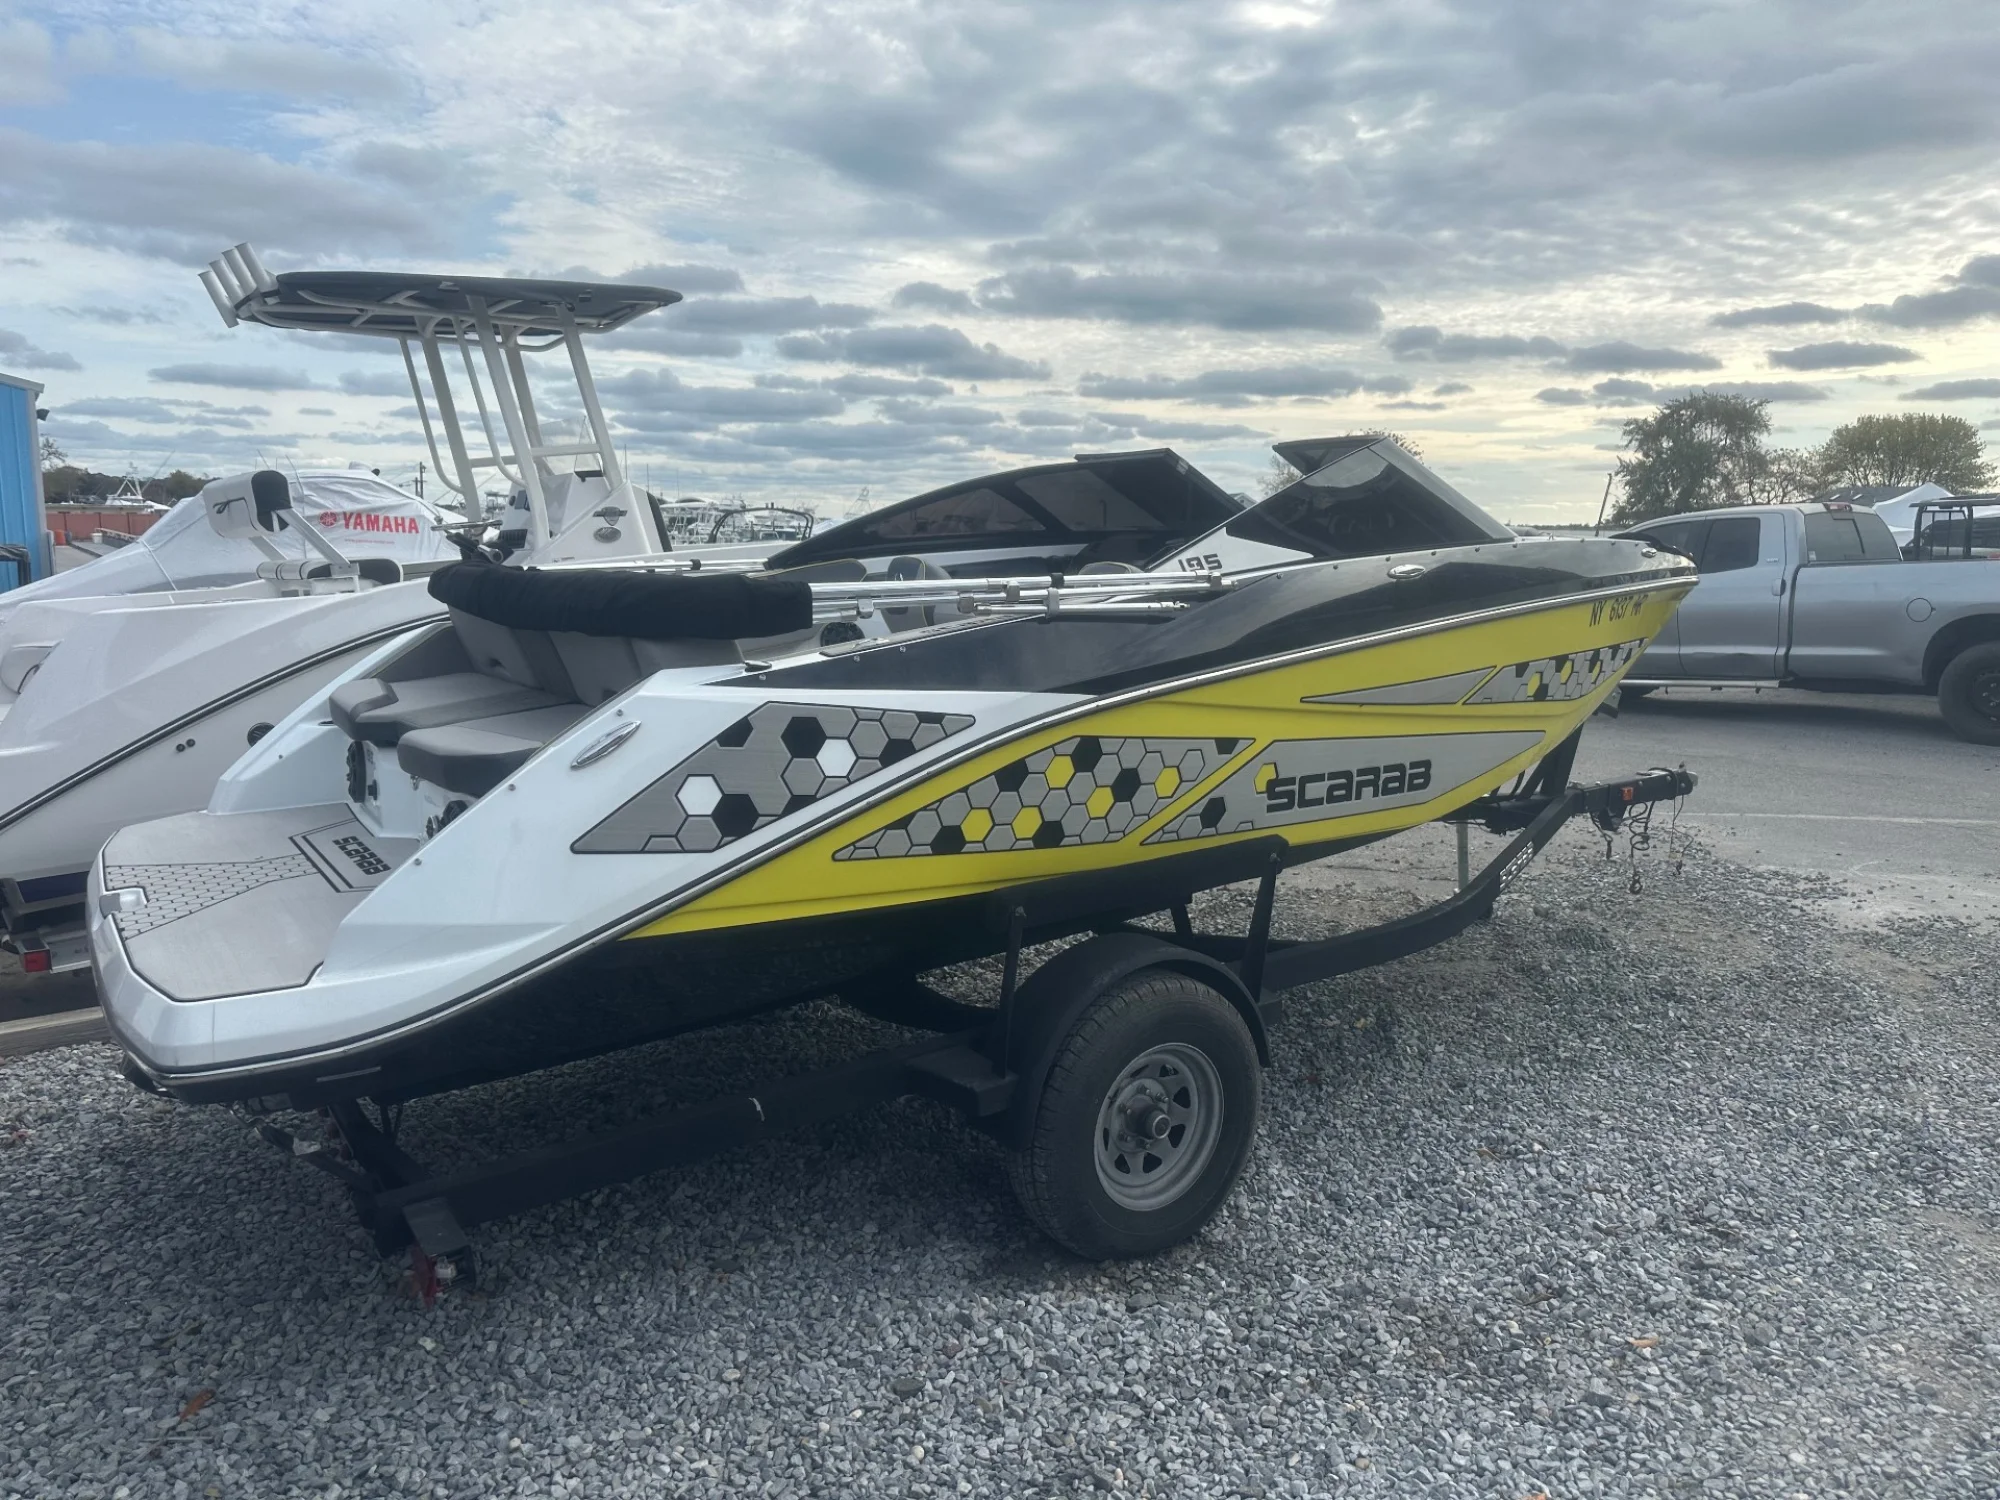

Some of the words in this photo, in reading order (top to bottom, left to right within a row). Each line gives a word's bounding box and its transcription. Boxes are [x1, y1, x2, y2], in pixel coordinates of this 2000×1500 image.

[342, 510, 419, 534] YAMAHA
[1177, 553, 1223, 572] 195
[1589, 600, 1607, 627] NY
[1609, 595, 1634, 621] 6137
